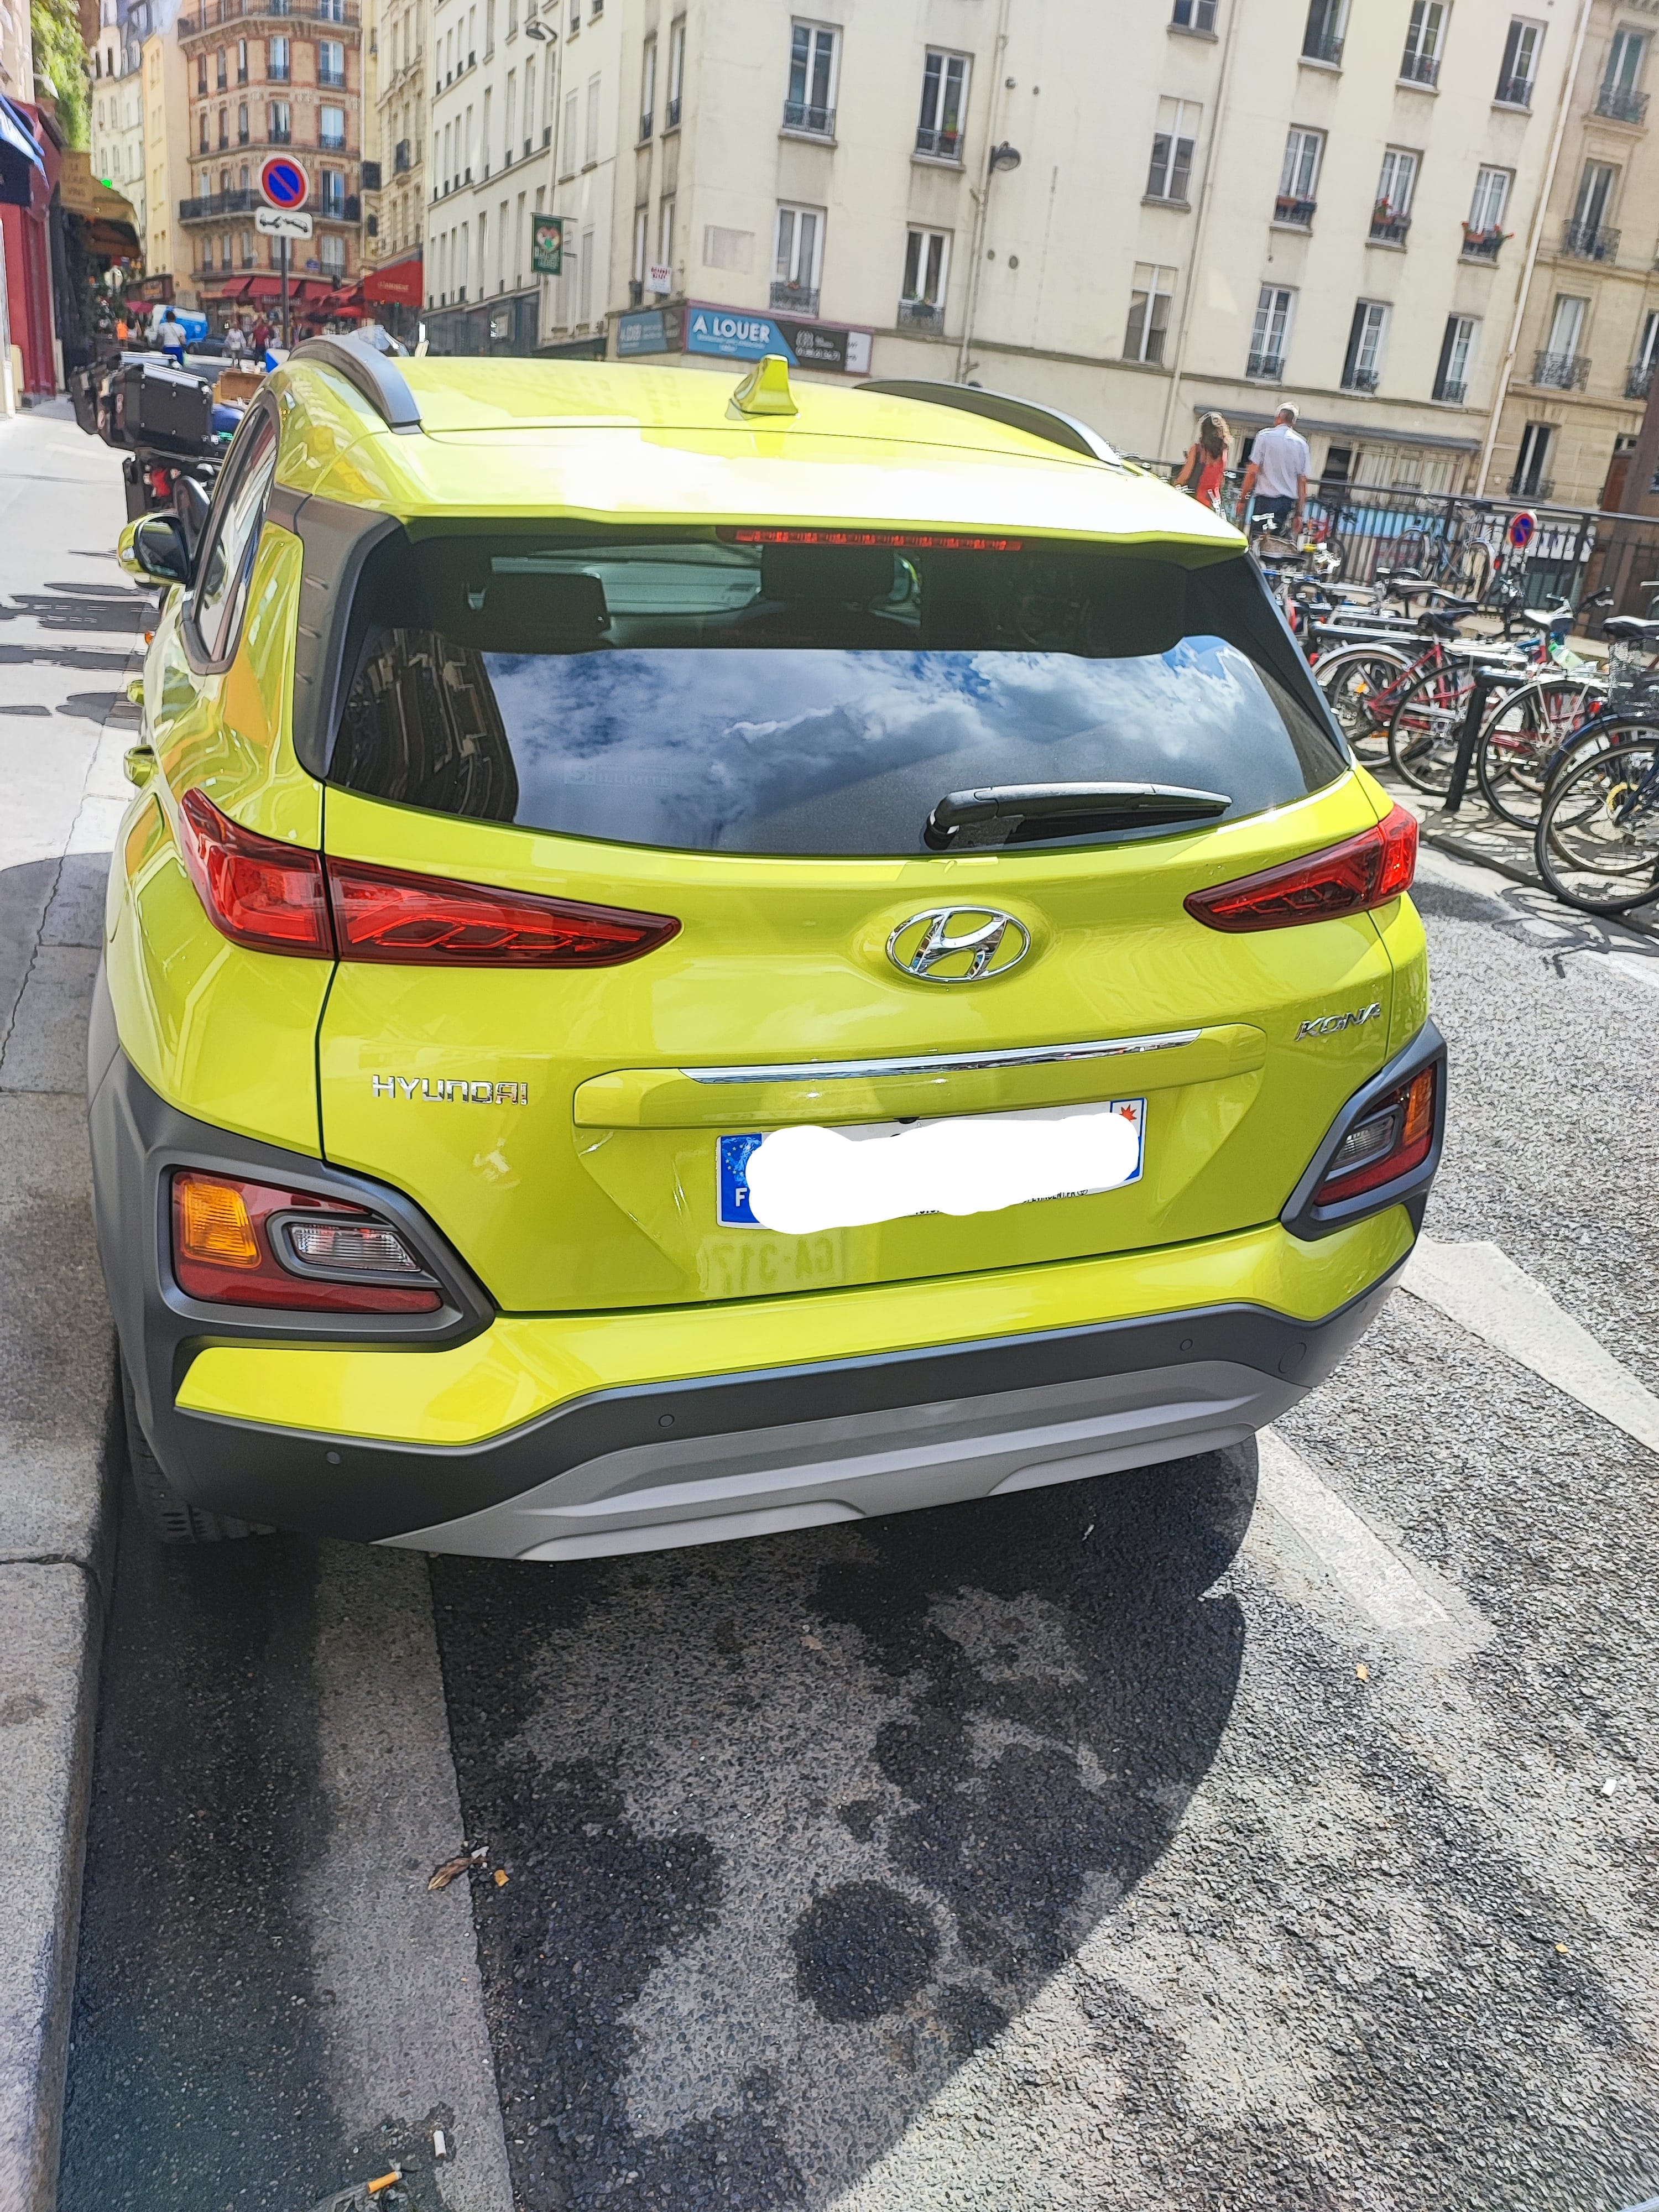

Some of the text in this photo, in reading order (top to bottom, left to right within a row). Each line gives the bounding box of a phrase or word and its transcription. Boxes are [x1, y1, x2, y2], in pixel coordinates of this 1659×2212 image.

[692, 314, 708, 334] A
[713, 316, 770, 344] LOUER
[1294, 1001, 1381, 1042] KONA
[372, 1074, 528, 1106] HYUNDAI
[735, 1187, 748, 1207] F
